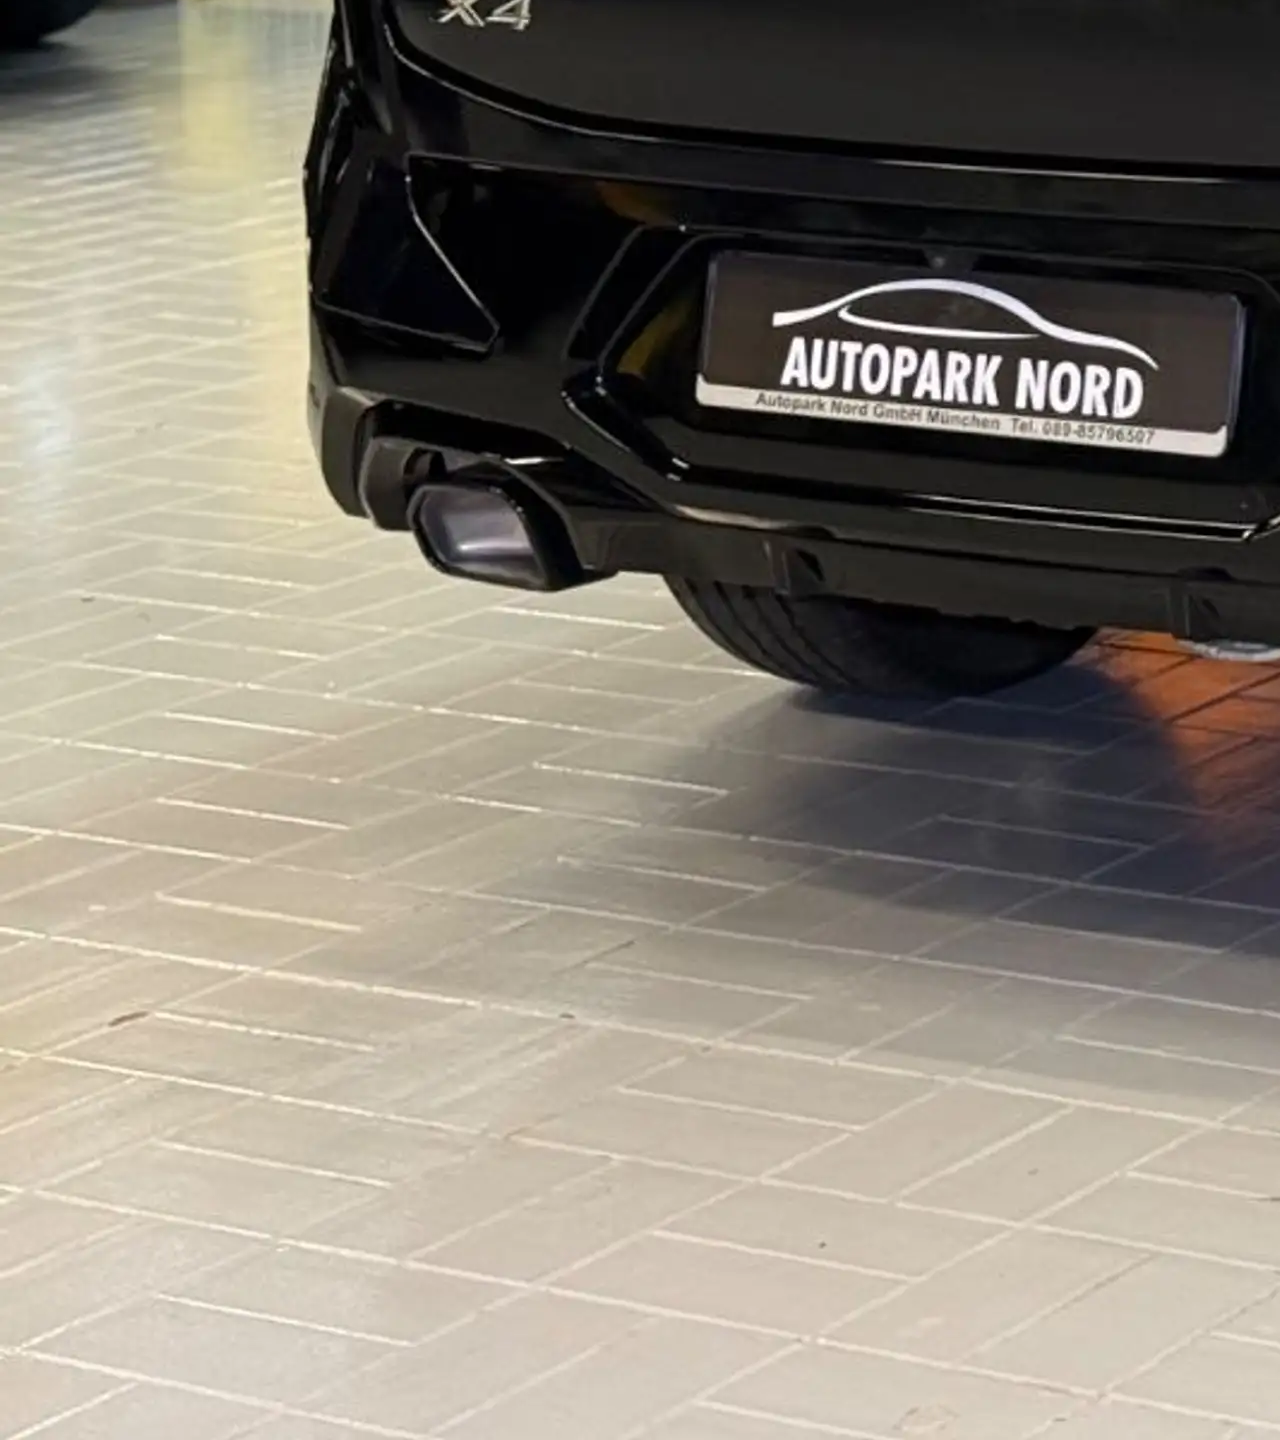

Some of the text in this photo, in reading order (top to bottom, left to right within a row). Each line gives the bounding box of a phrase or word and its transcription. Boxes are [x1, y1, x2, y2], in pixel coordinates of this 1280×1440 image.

[780, 336, 1144, 419] AUTOPARK NORD
[756, 392, 825, 412] Autopark
[832, 400, 869, 417] Nord
[927, 408, 1000, 431] München
[1011, 417, 1037, 434] Tel.
